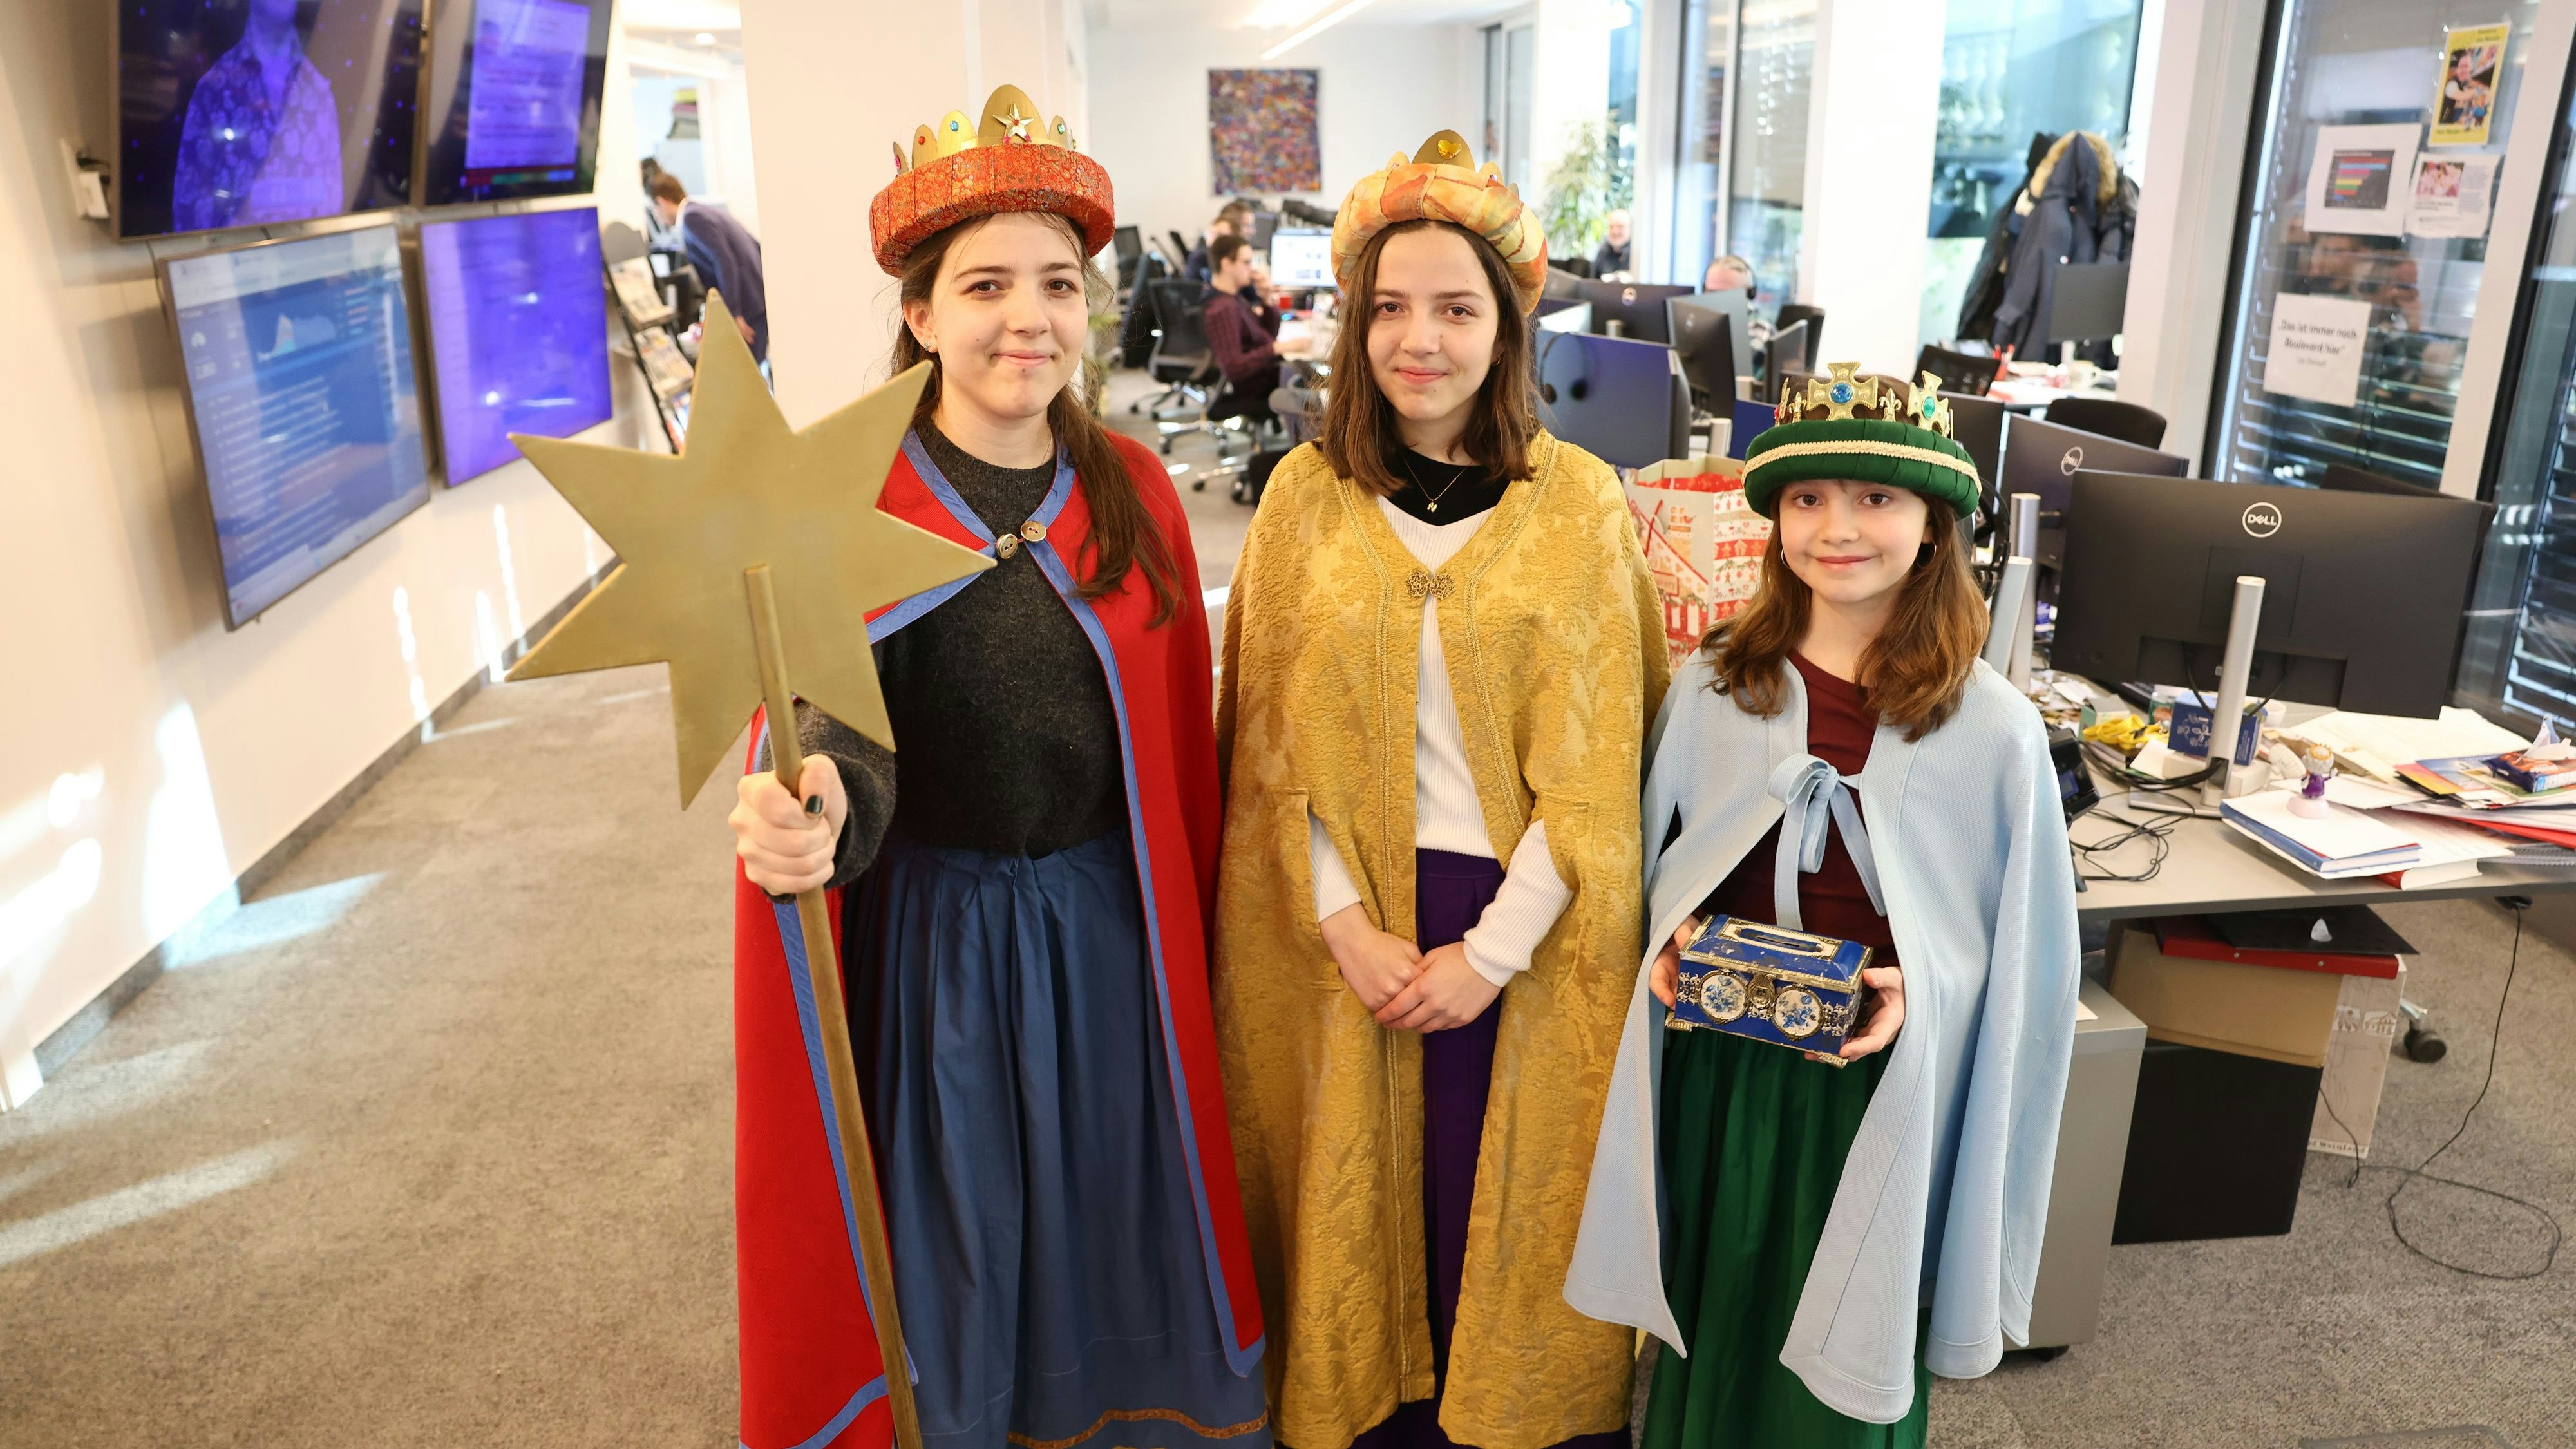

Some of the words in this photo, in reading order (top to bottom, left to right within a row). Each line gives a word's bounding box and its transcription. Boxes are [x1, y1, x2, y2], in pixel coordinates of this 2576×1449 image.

[2297, 321, 2307, 332] ist
[2309, 323, 2335, 336] immer
[2336, 328, 2357, 339] noch
[2284, 337, 2324, 354] Boulevard
[2248, 514, 2277, 526] DELL
